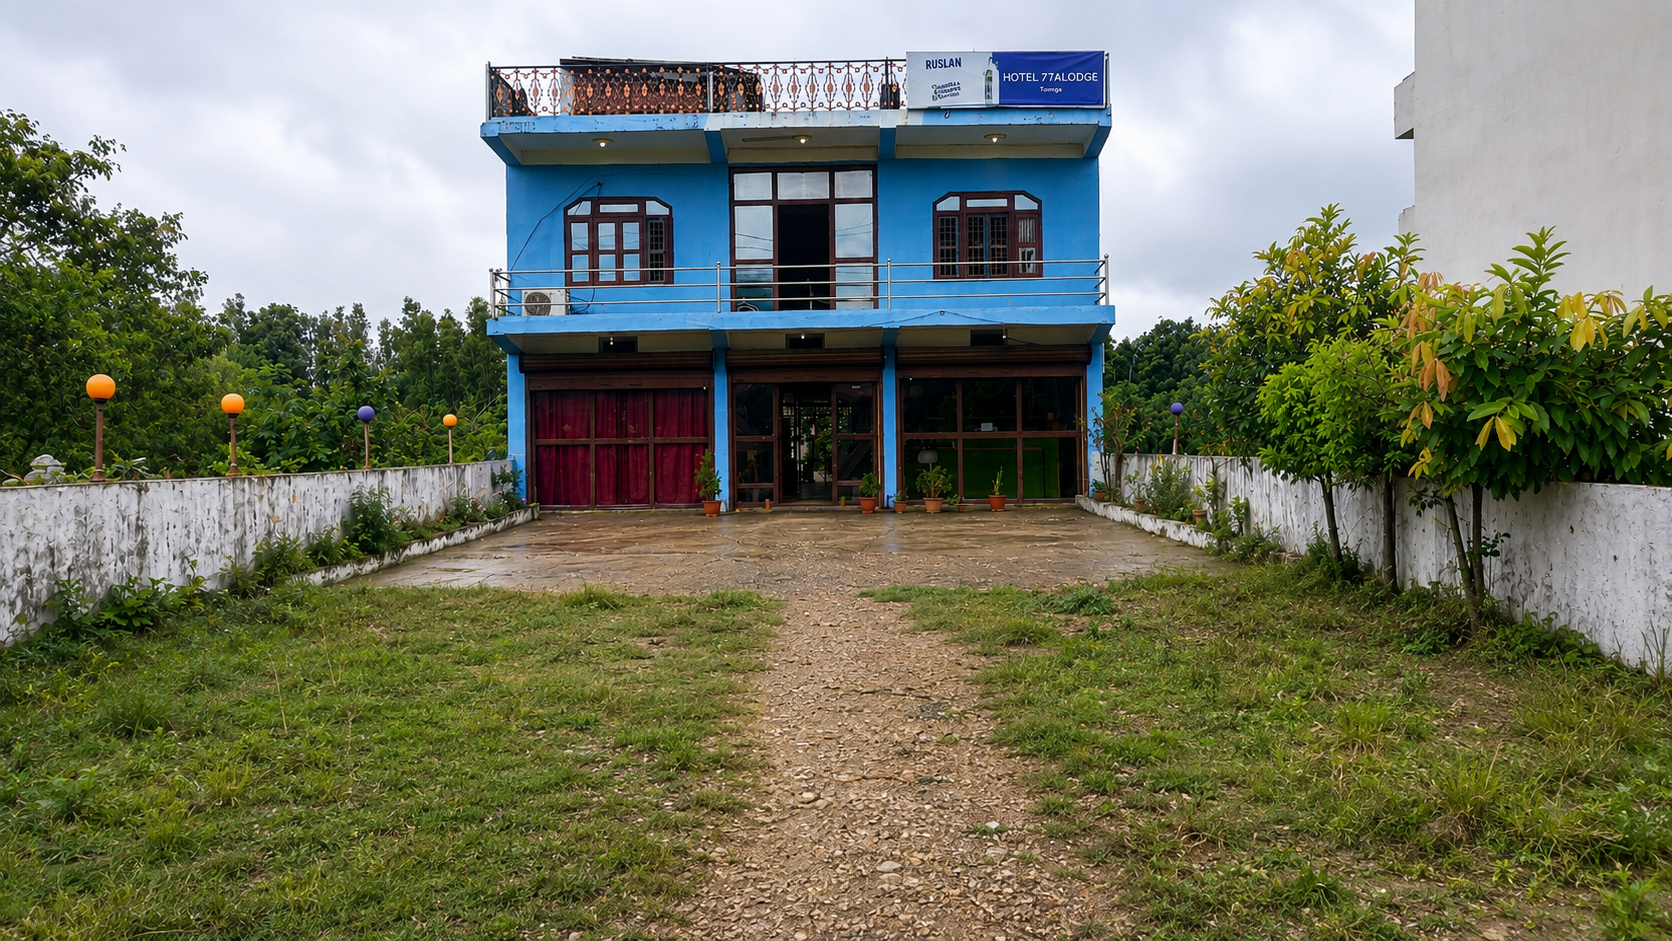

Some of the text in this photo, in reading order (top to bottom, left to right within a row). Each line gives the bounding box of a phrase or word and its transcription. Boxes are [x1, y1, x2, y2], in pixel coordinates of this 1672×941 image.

[925, 57, 962, 70] RUSLAN
[1003, 72, 1098, 82] HOTEL 77ALODGE
